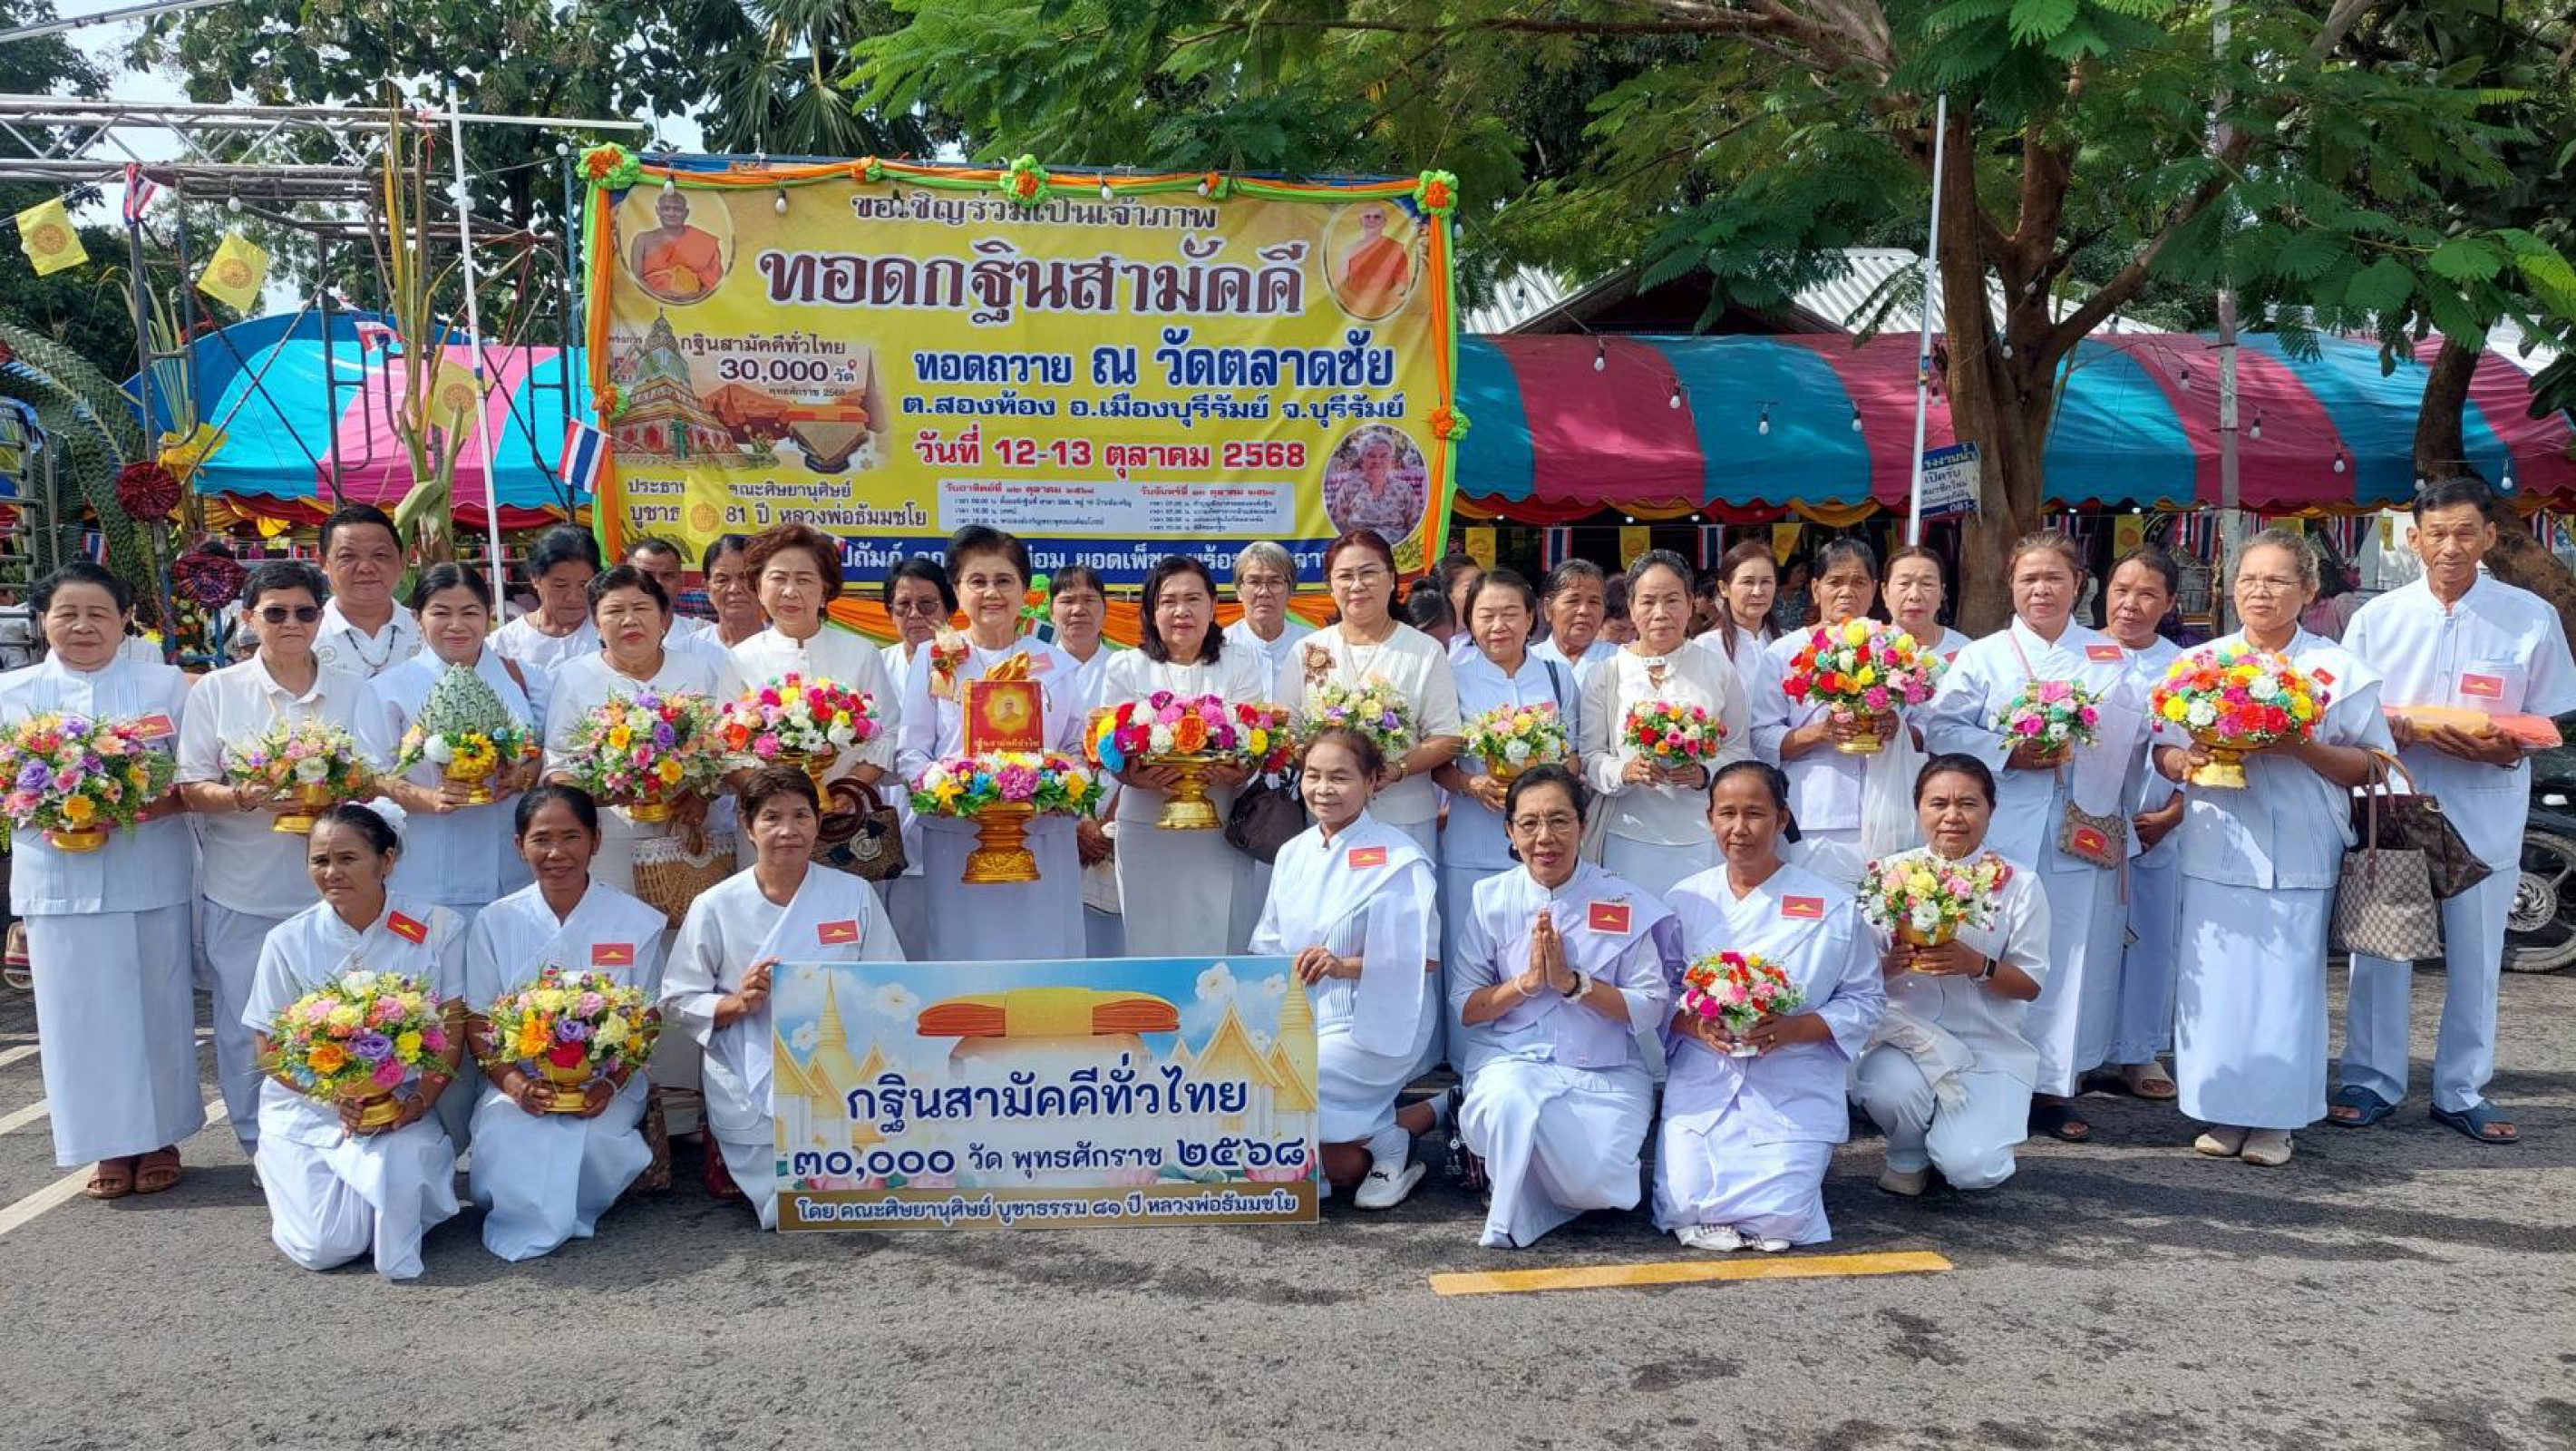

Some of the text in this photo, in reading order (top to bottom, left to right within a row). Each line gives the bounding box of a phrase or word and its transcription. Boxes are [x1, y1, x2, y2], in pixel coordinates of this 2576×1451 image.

[852, 190, 1217, 229] ขอเชิญร่วมเป็นเจ้าภาพ
[759, 235, 1305, 324] ทอดกฐินสามัคคี
[680, 330, 846, 355] กฐินสามัคคีทั่วไทย
[914, 327, 1394, 387] ทอดถวาย ณ วัดตลาดชัย
[720, 358, 829, 383] 30,000
[903, 390, 1405, 428] ต.สองห้อง อ.เมืองบุรีรัมย์ จ.บุรีรัมย์
[915, 424, 1305, 479] วันที่ 12-13 ตุลาคม 2568
[1923, 444, 1977, 468] รงงานน้ำ
[628, 479, 685, 494] ประธา
[726, 506, 746, 523] 81
[755, 502, 770, 524] ปี
[779, 502, 927, 526] หลวงพ่อธัมมชโย
[847, 1053, 1247, 1134] กฐินสามัคคีทั่วไทย
[793, 1136, 1305, 1179] ๓๐,๐๐๐ วัด พุทธศักราช ๒๕๖๘
[798, 1190, 1297, 1223] โดย คณะศิษยานุศิษย์ บูชาธรรม ๘๑ ปี หลวงพ่อธัมมชโย
